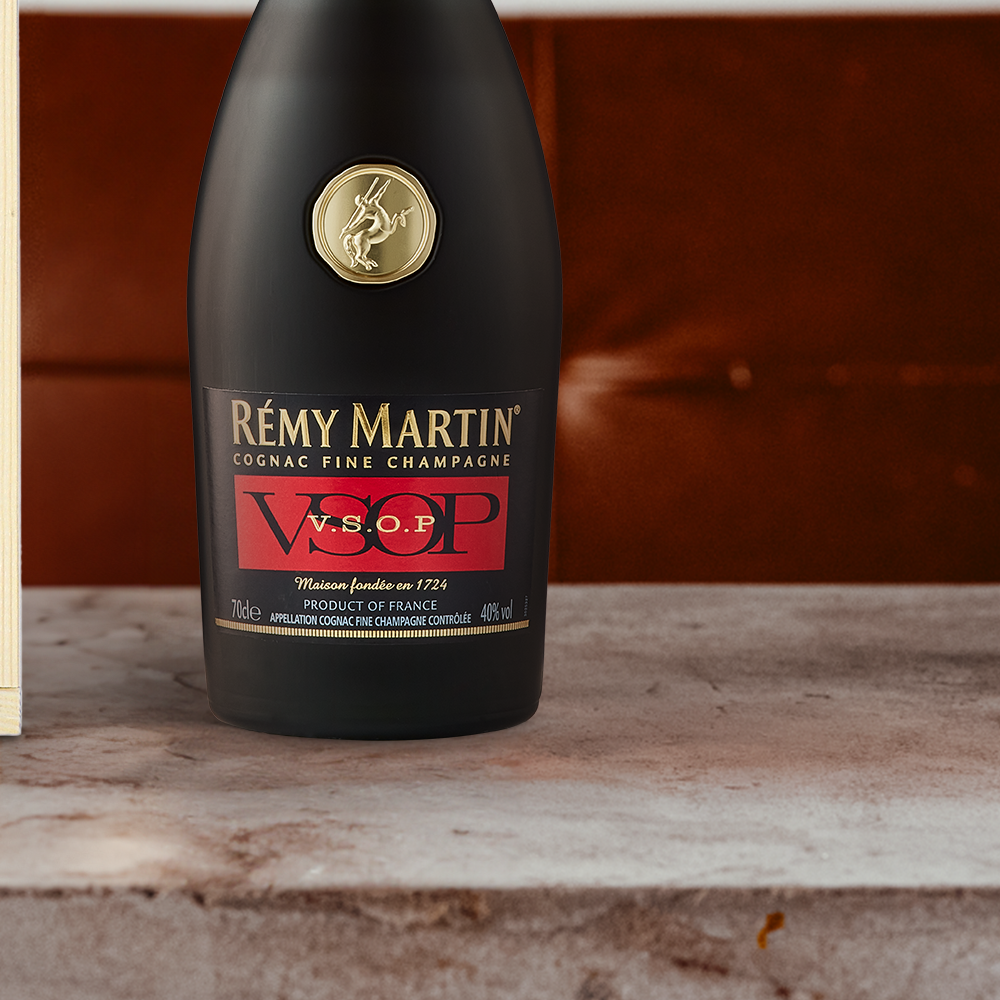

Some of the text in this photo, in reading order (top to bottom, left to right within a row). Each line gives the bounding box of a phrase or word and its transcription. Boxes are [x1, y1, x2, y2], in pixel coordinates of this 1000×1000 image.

[231, 398, 340, 449] RÉMY
[232, 452, 511, 470] COGNAC FINE CHAMPAGNE
[242, 491, 501, 557] VSOP
[307, 515, 436, 533] V.S.O.P
[294, 575, 448, 595] Maison fondée en 1724
[303, 599, 438, 612] PRODUCT OF FRANCE
[480, 602, 500, 622] 40%
[501, 598, 514, 620] vol
[269, 610, 472, 628] APPELLATION COGNAC FINE CHAMPAGNE CONTRÔLÉE
